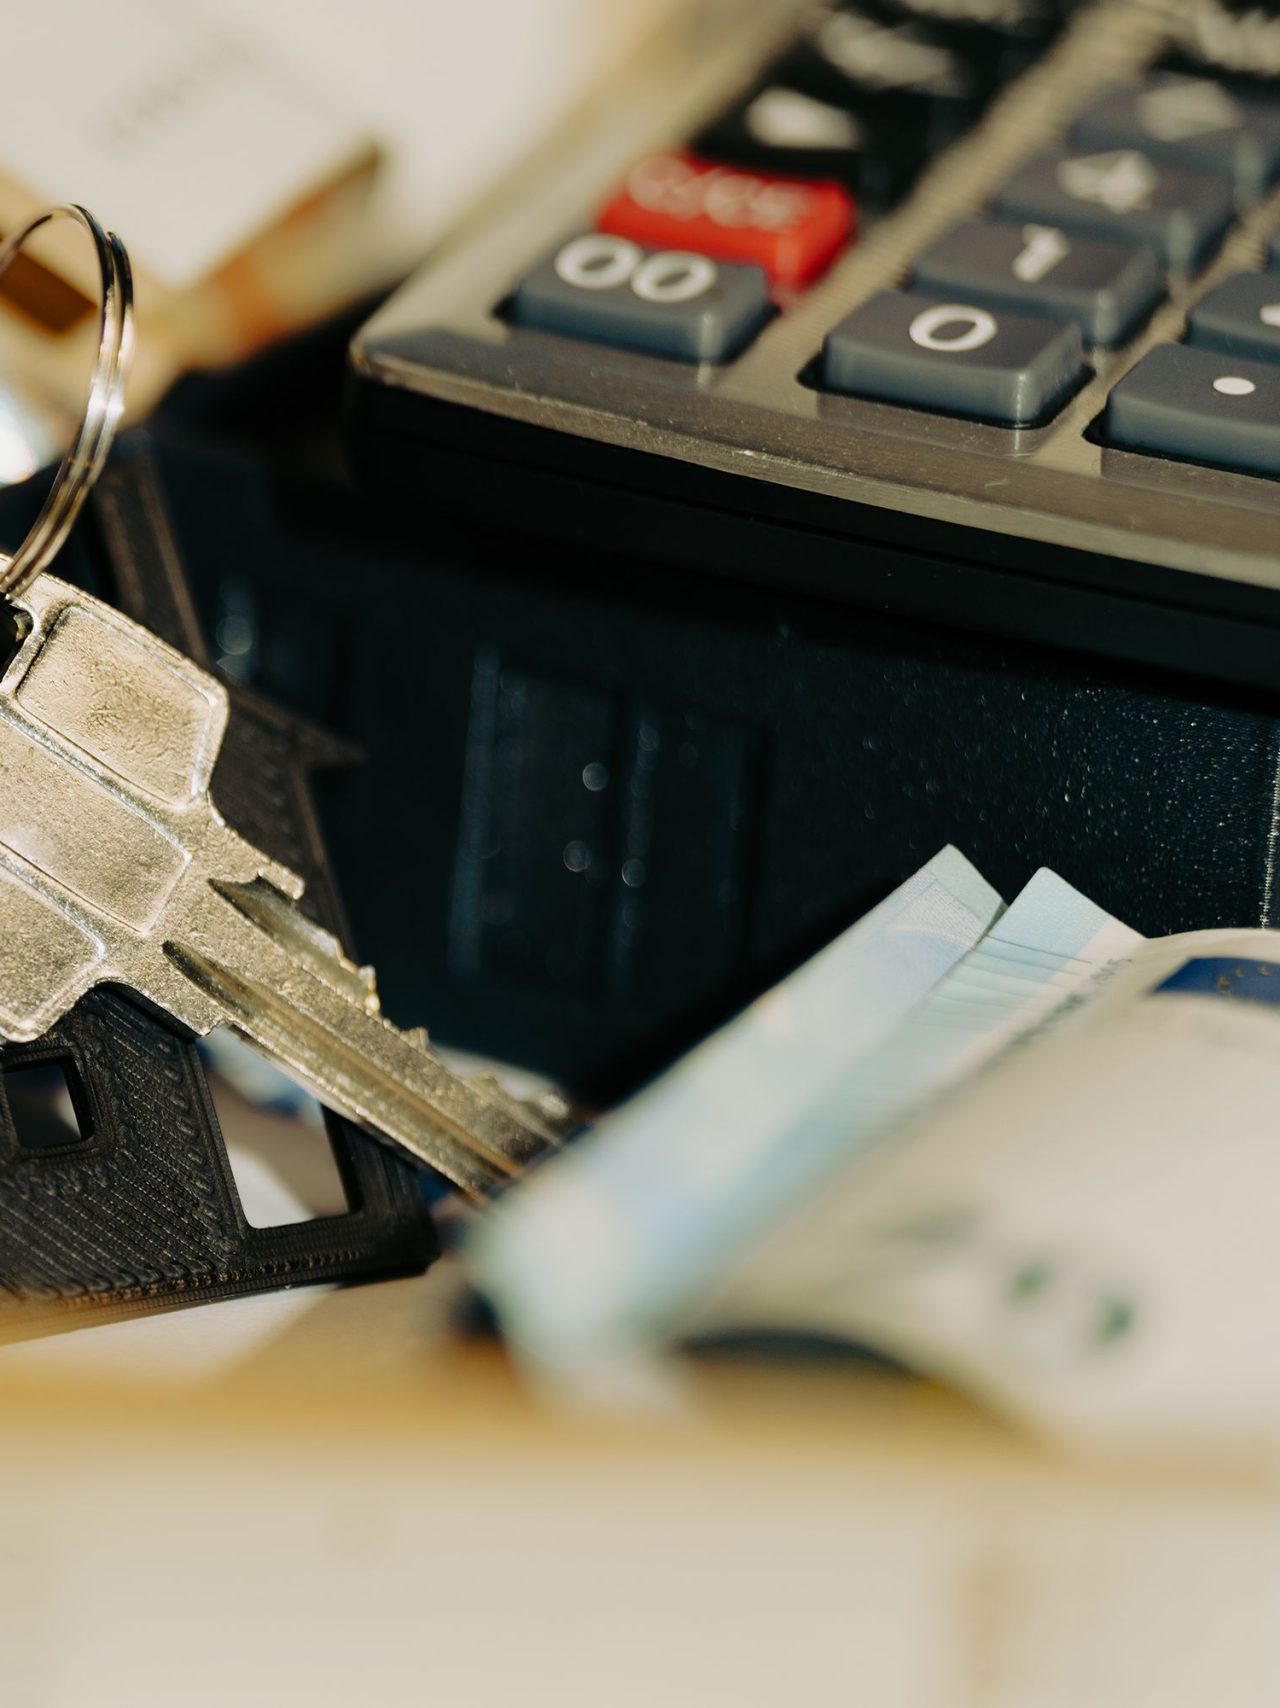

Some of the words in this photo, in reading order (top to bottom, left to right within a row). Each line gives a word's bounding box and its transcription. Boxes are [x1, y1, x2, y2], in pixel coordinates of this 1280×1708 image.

[555, 234, 716, 301] 00
[1012, 223, 1069, 282] 1
[909, 304, 997, 352] 0
